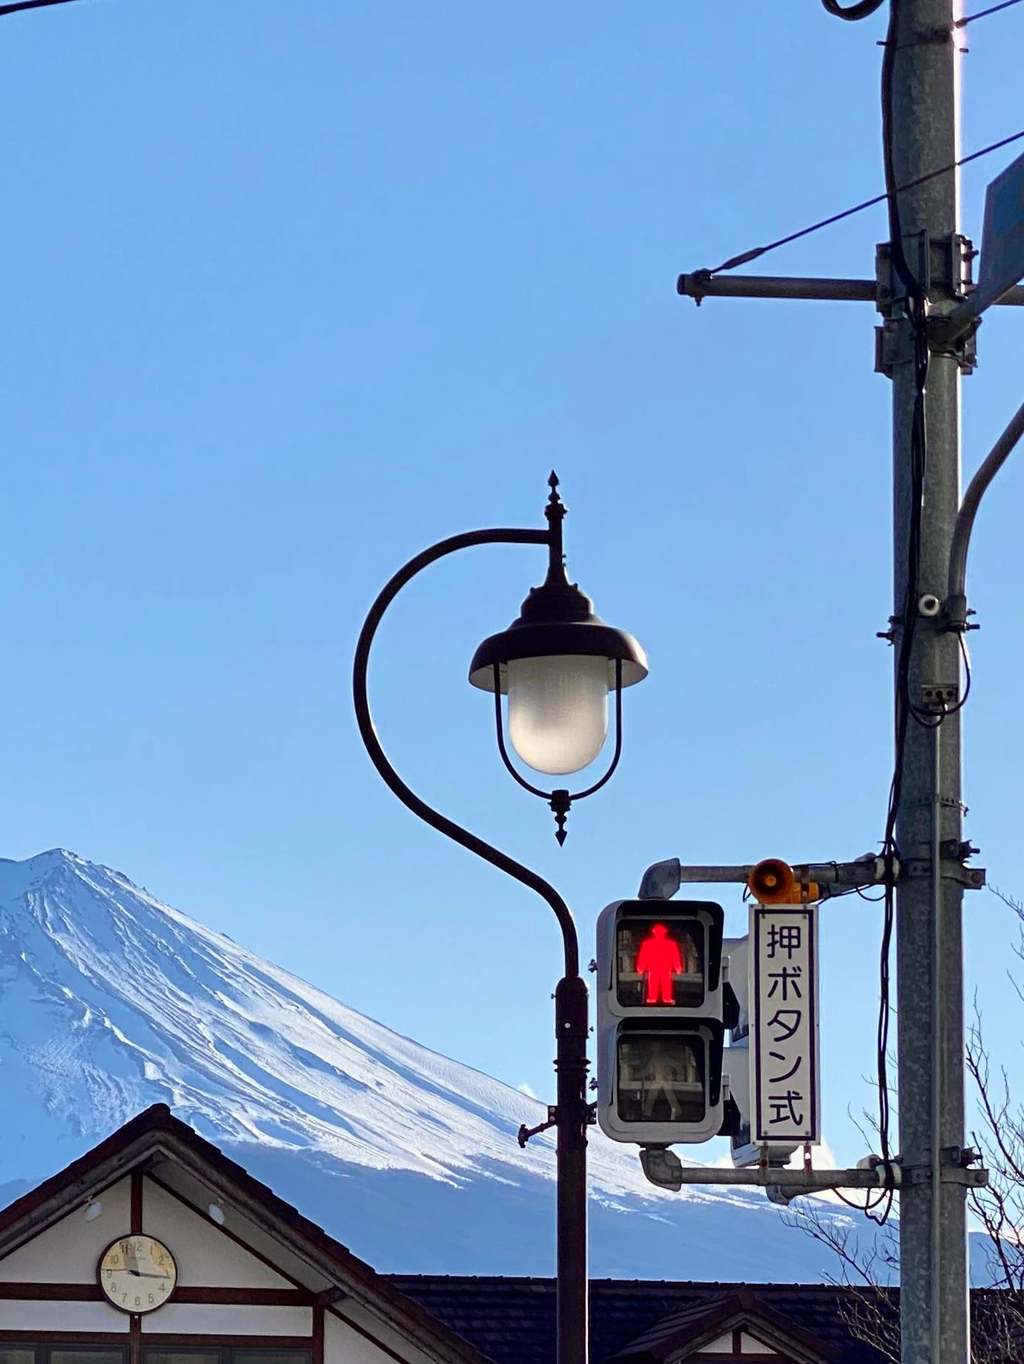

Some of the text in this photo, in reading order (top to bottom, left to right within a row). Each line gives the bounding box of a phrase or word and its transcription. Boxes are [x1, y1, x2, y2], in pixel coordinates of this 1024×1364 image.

[766, 924, 803, 1127] 押ボタン式
